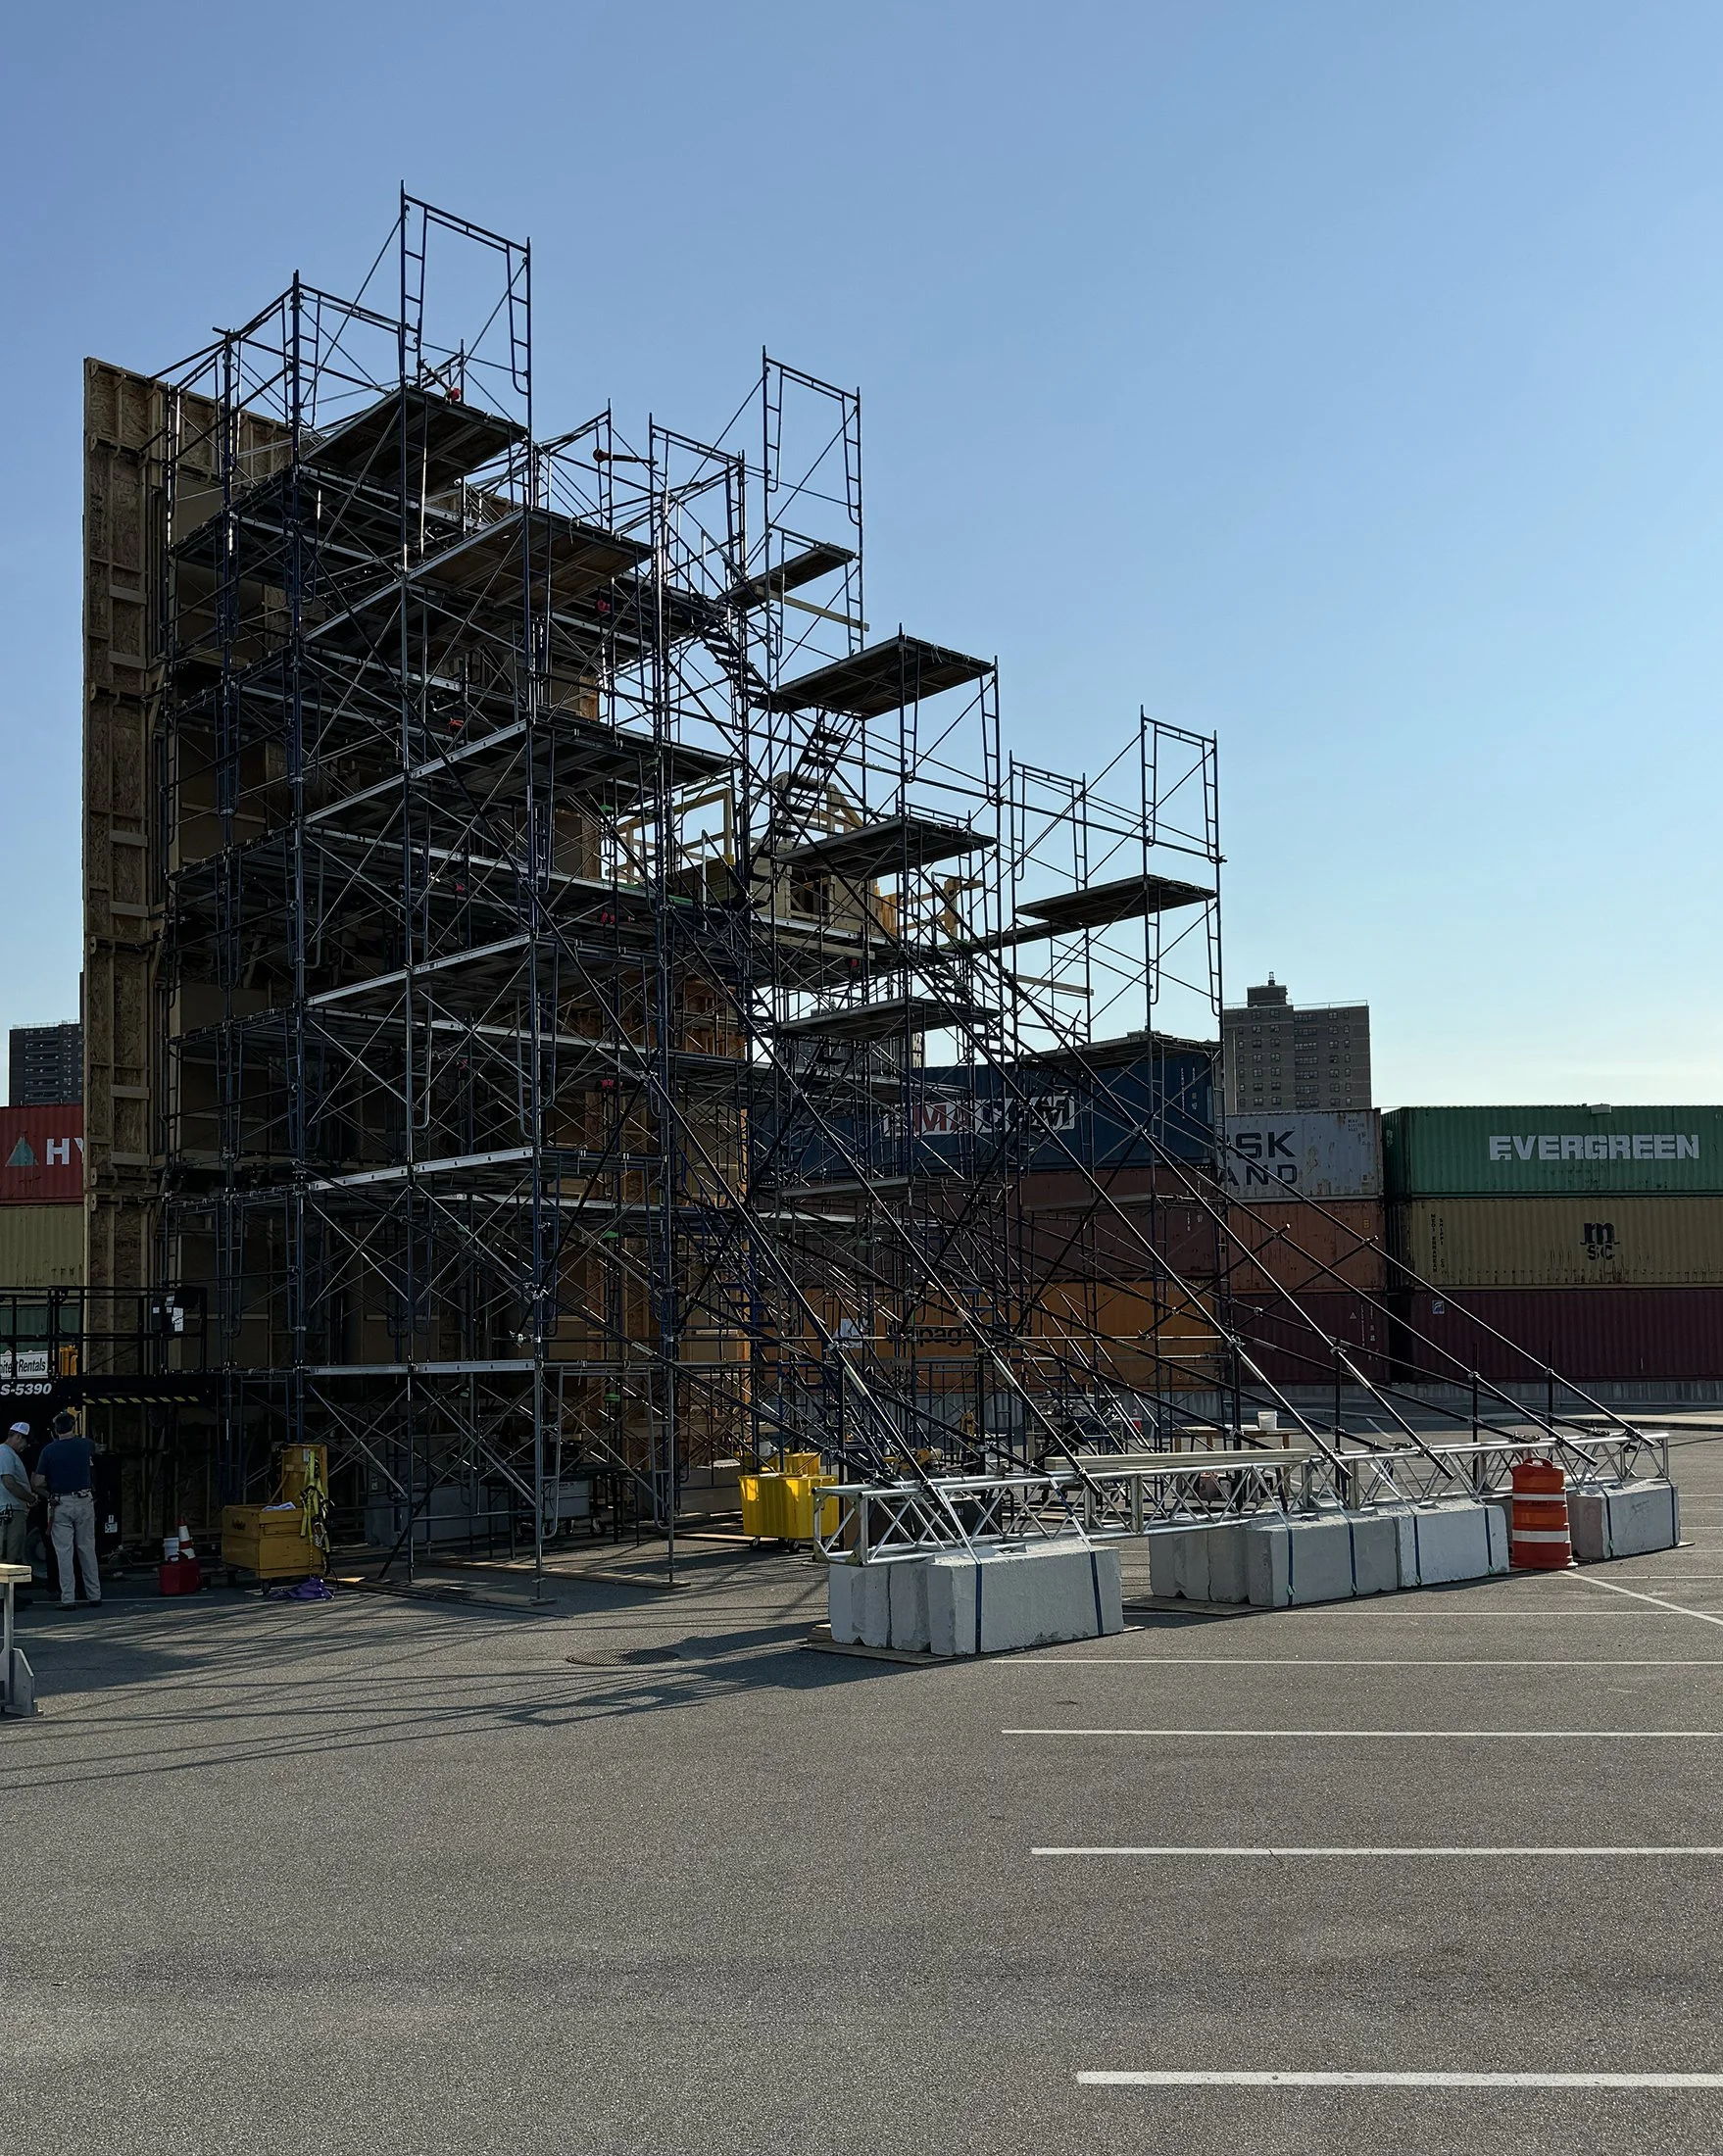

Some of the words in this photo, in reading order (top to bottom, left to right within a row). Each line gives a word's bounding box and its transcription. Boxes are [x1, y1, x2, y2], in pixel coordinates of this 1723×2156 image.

[1227, 1131, 1295, 1158] SK
[1489, 1134, 1699, 1161] EVERGREEN
[18, 1357, 46, 1373] Rentals
[0, 1382, 53, 1396] S-5390
